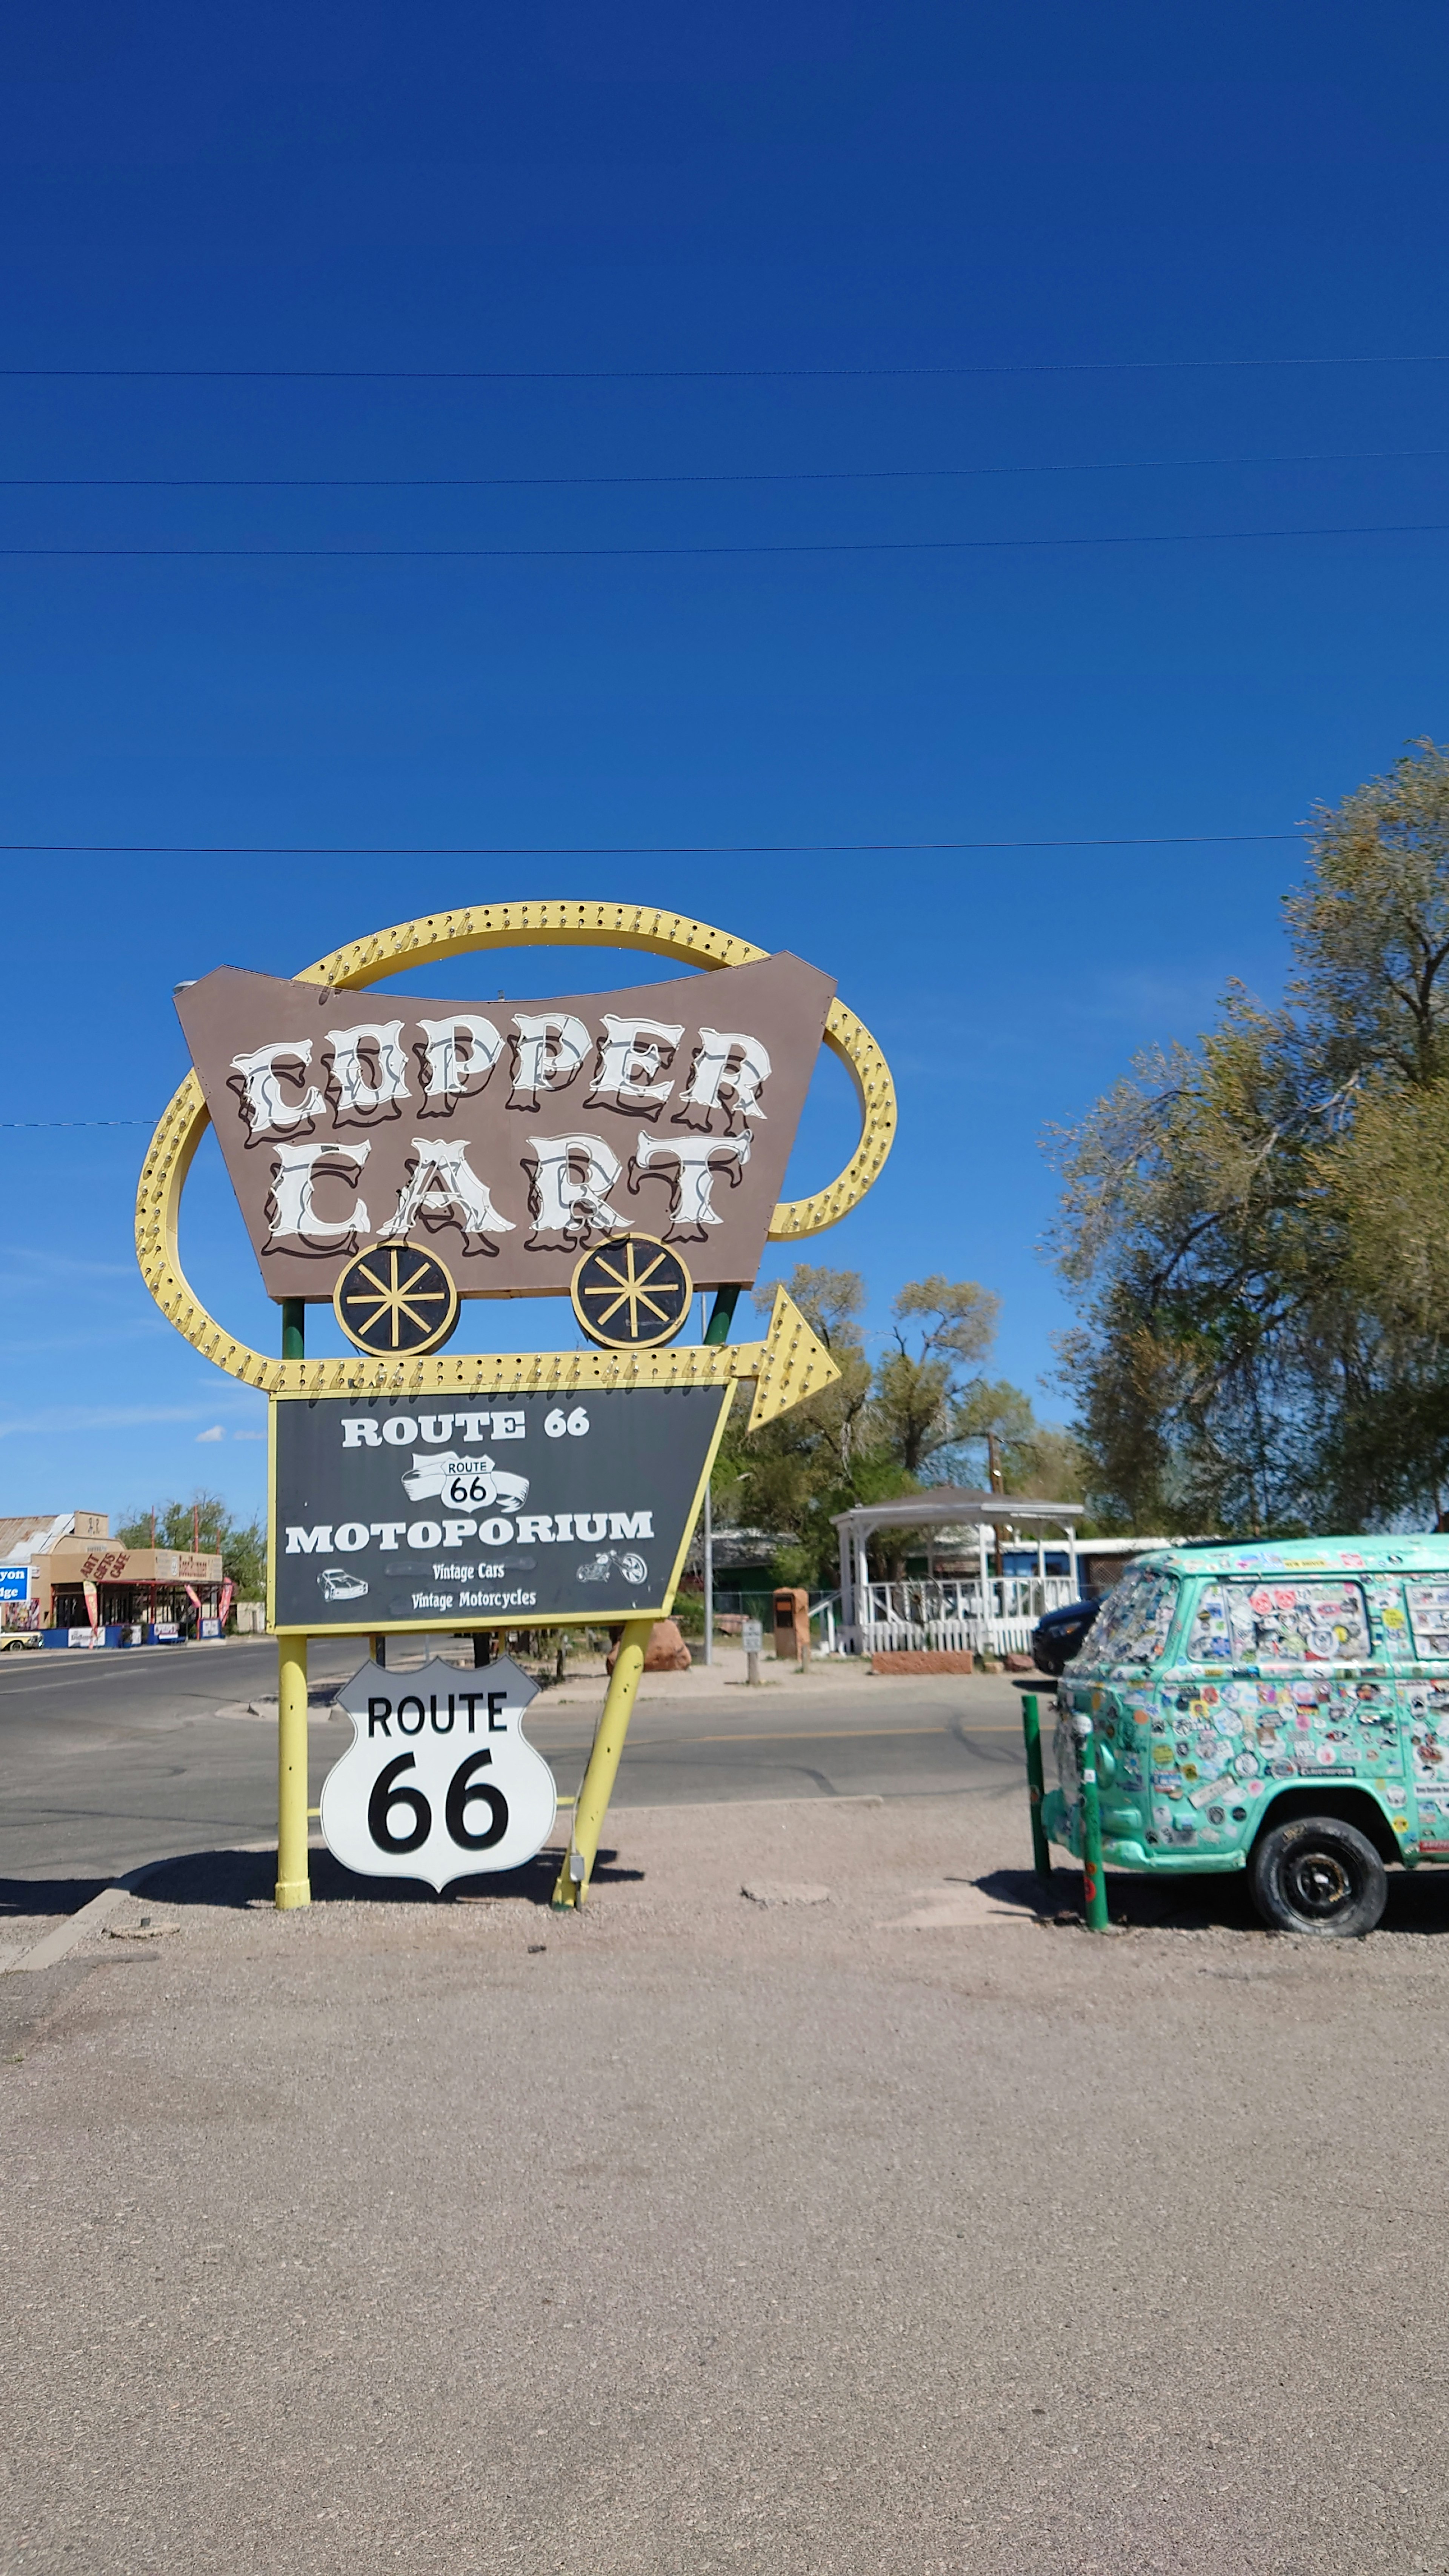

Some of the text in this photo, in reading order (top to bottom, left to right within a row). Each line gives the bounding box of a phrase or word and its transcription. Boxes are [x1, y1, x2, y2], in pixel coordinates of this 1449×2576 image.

[229, 1013, 773, 1132] COPPER
[268, 1129, 754, 1237] CART
[341, 1406, 589, 1447] ROUTE 66
[449, 1462, 486, 1473] ROUTE
[451, 1476, 486, 1503] 66
[285, 1511, 654, 1554] MOTOPORIUM
[80, 1553, 99, 1578] ART
[94, 1553, 115, 1579] GIFTS
[110, 1553, 131, 1578] CAFE
[433, 1563, 505, 1583] Vintage Cars
[412, 1589, 537, 1612] Vintage Motorcycles
[368, 1692, 507, 1737] ROUTE
[368, 1748, 509, 1854] 66
